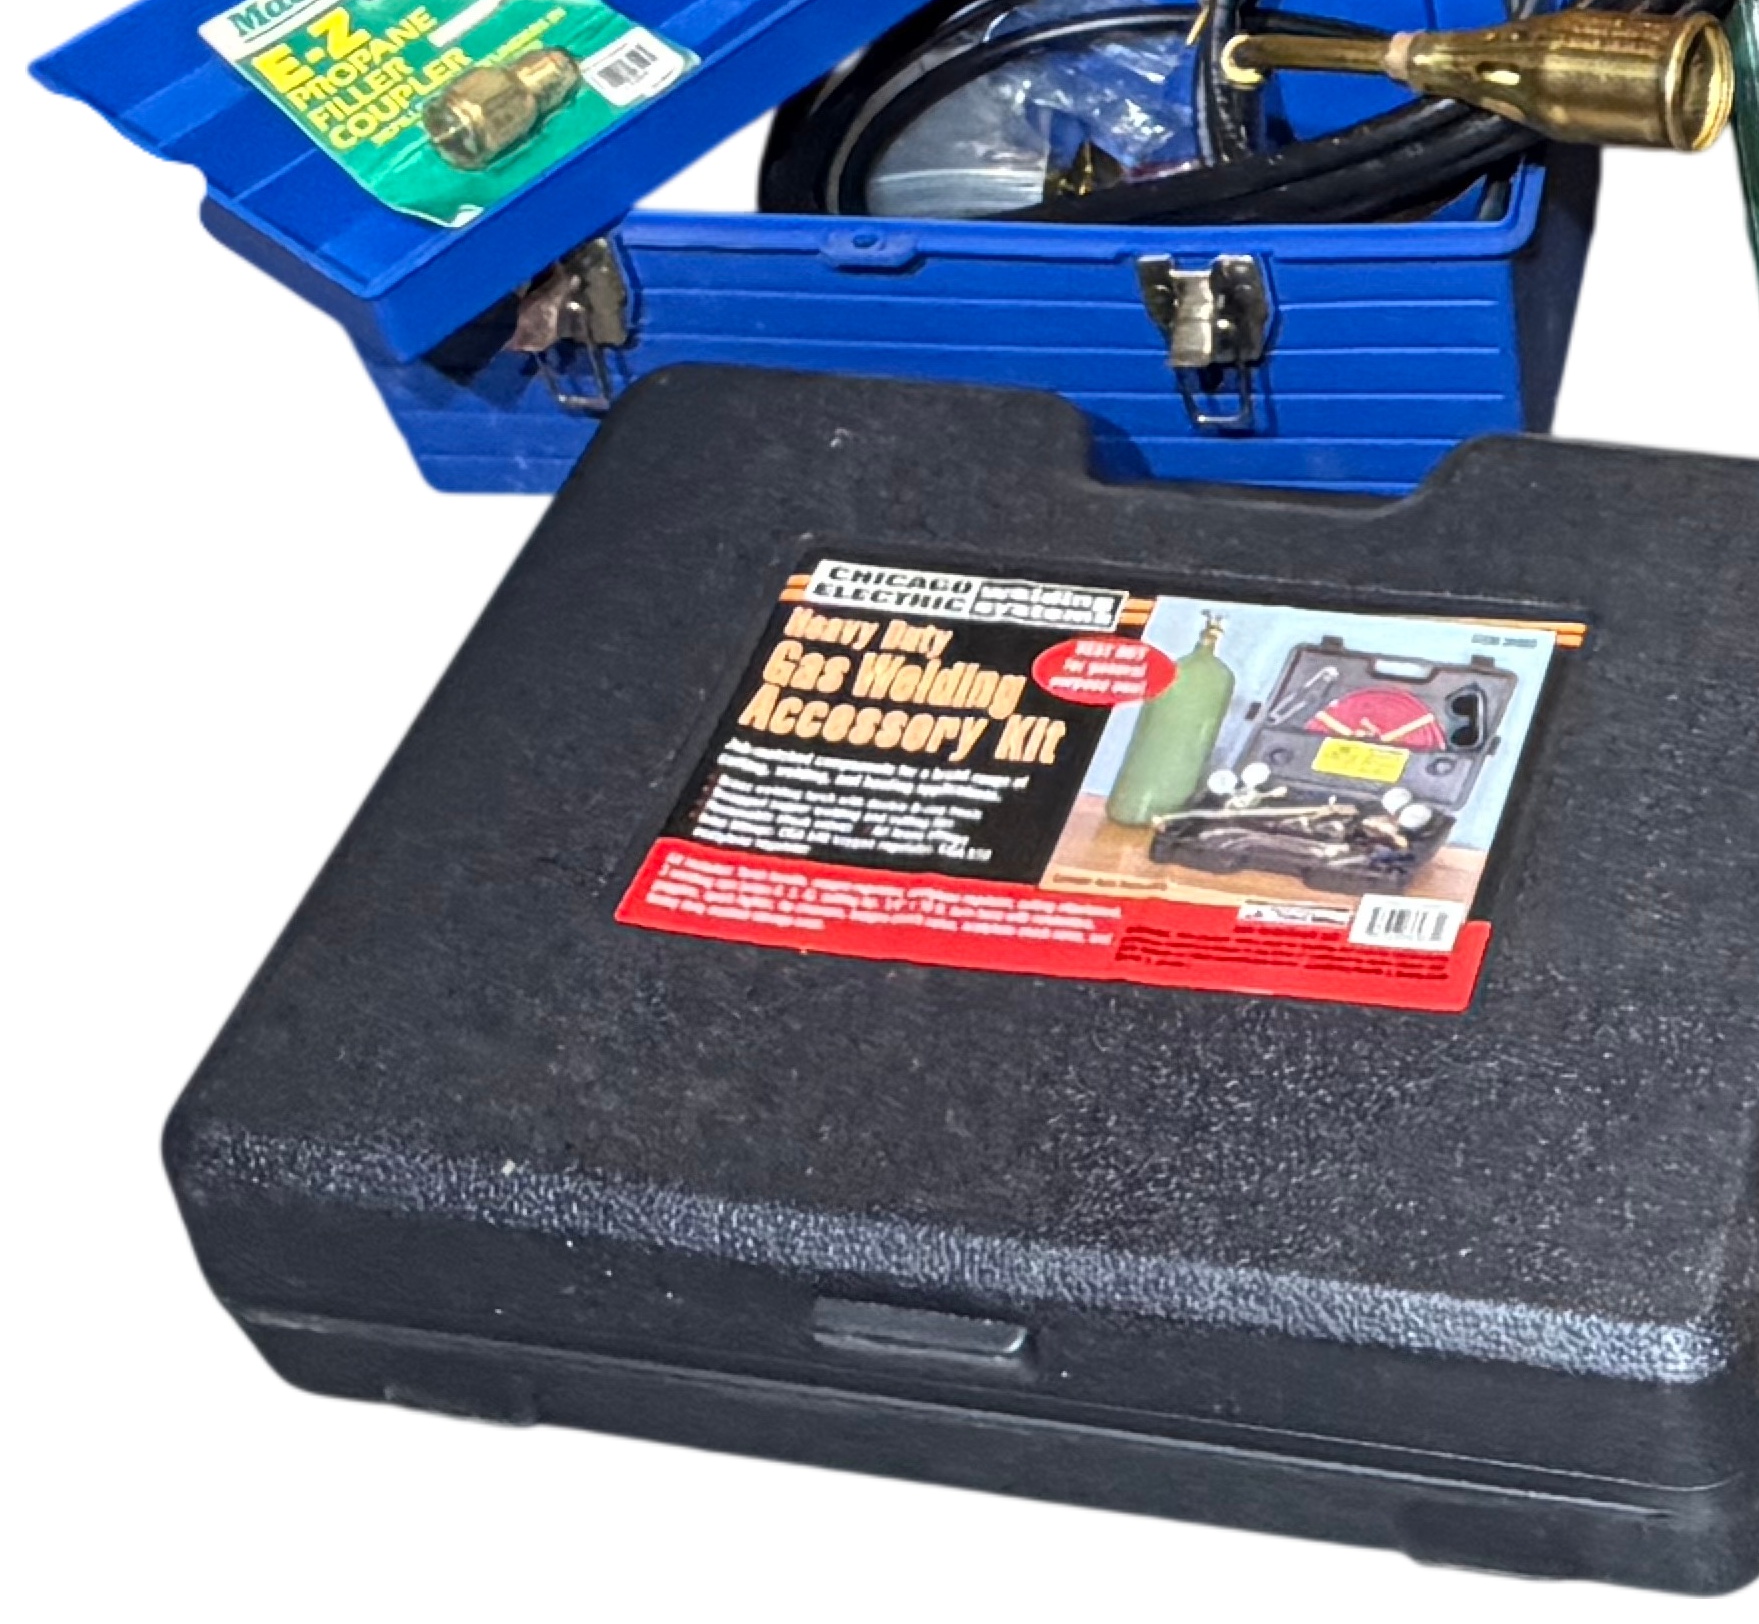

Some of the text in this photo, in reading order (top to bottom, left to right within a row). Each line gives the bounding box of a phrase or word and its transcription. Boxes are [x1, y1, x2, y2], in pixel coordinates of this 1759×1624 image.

[252, 6, 372, 94] E-Z
[286, 4, 438, 112] PROPANE
[307, 56, 414, 133] FILLER
[328, 47, 473, 150] COUPLER
[812, 582, 967, 612] ELECTRIC
[829, 565, 972, 594] CHICAGO
[974, 601, 1113, 625] systems
[981, 585, 1115, 612] welding
[783, 606, 953, 660] Heavy Duty
[762, 639, 1027, 720] Gas Welding
[738, 682, 1066, 765] Accessory Kit
